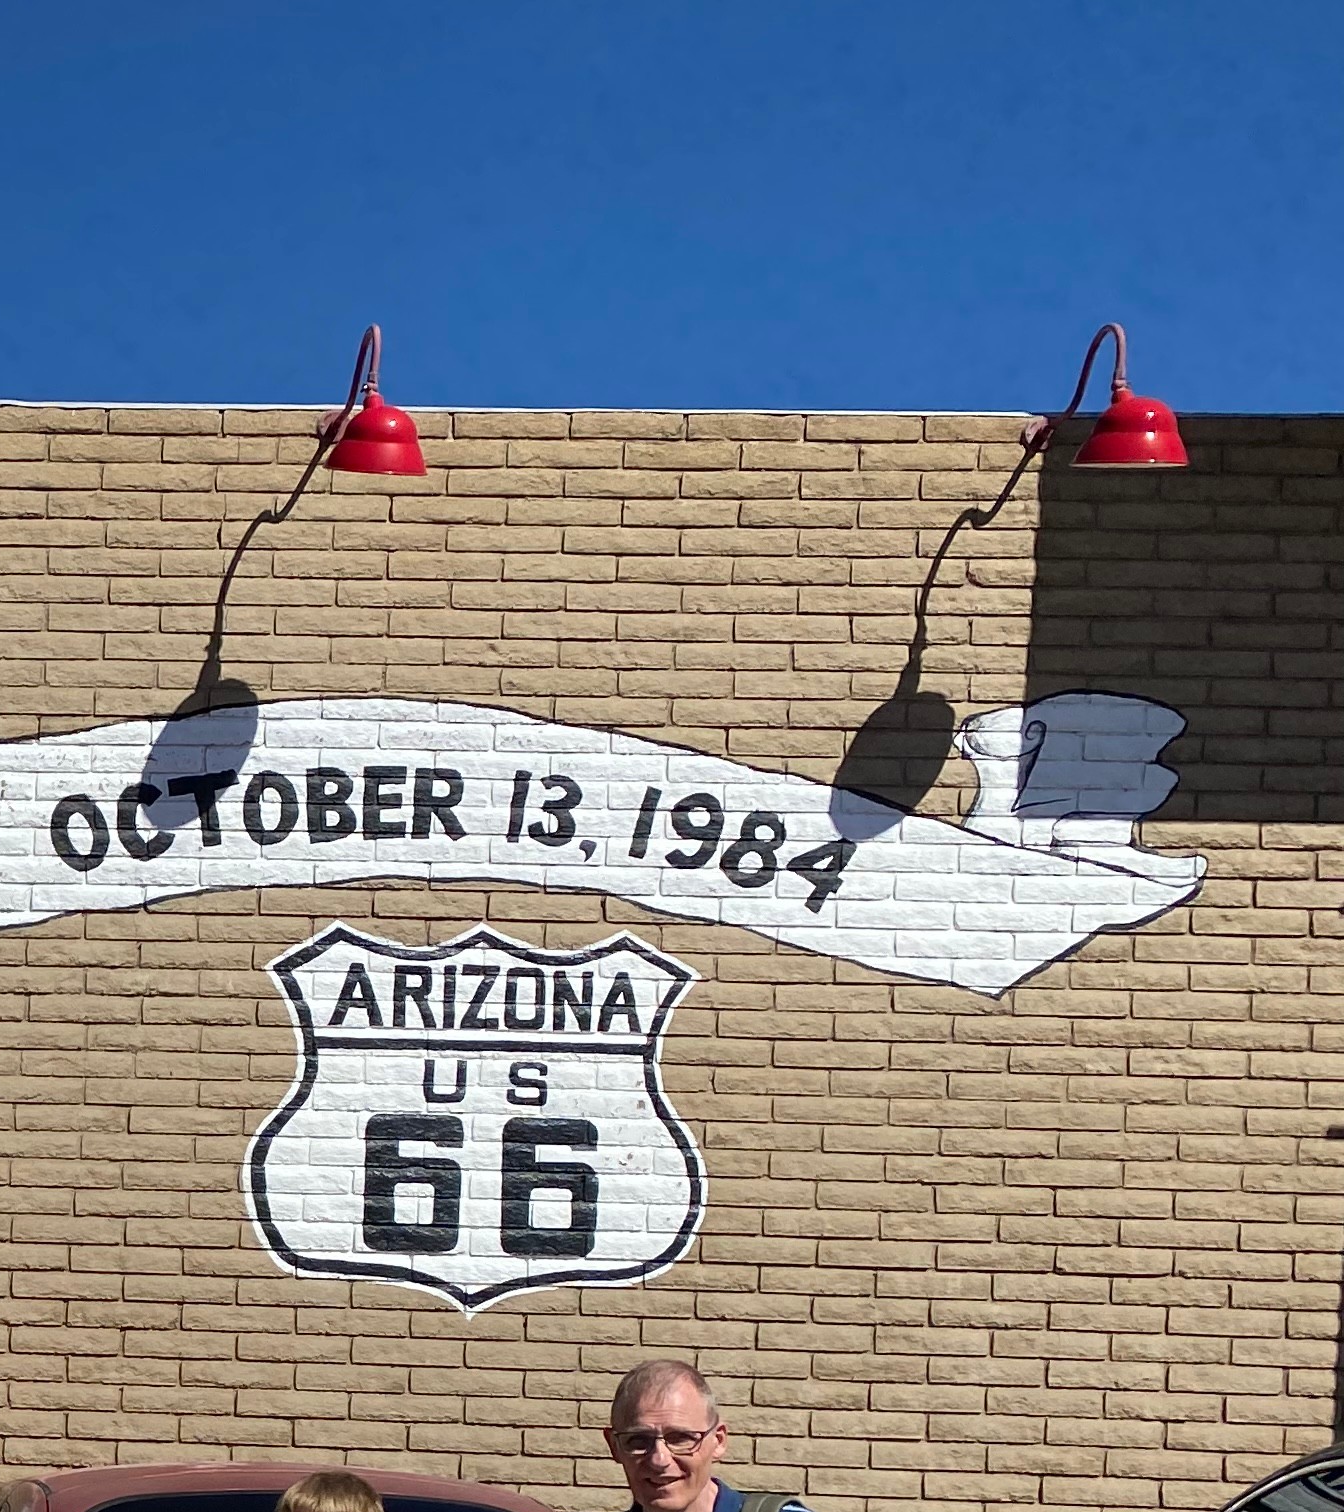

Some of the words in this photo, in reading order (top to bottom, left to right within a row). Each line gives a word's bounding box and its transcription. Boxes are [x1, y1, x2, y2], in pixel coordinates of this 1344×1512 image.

[49, 766, 470, 873] OCTOBER
[505, 771, 599, 865] 13,
[626, 784, 859, 914] 1984
[327, 961, 641, 1034] ARIZONA
[361, 1112, 602, 1259] 66
